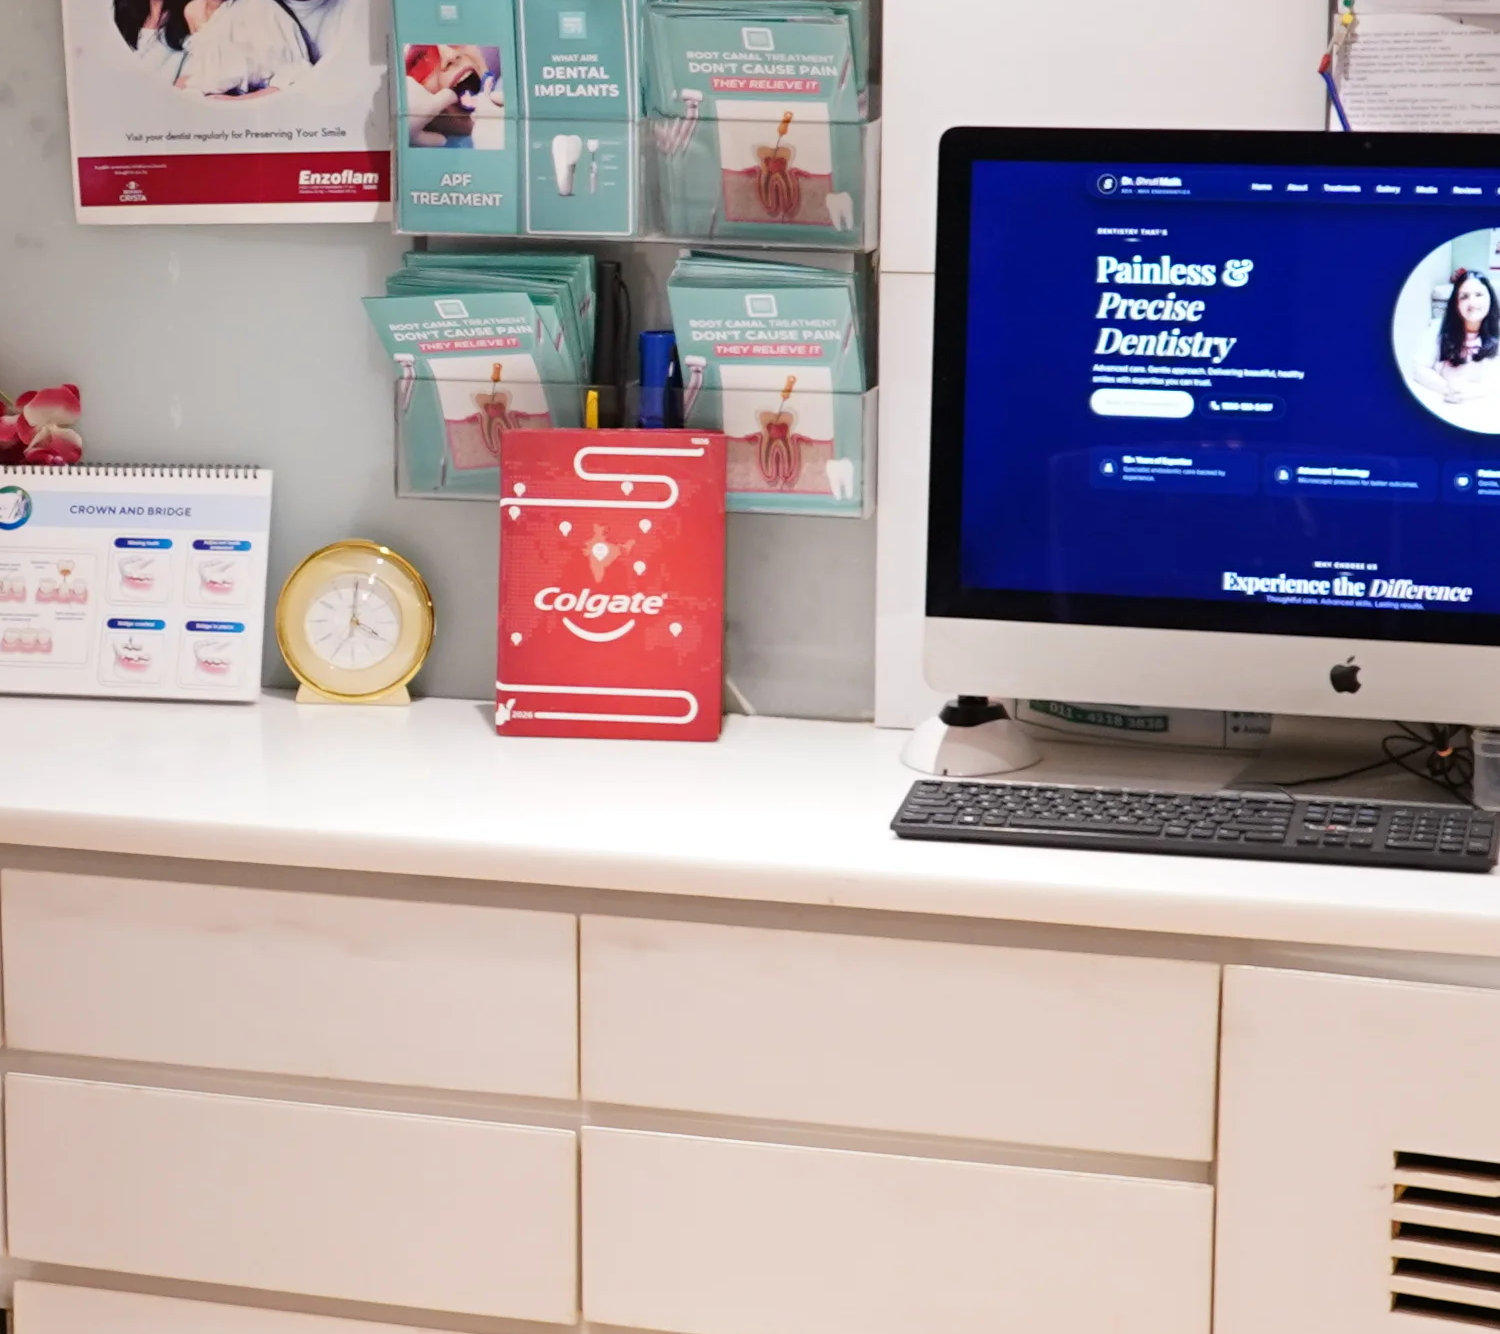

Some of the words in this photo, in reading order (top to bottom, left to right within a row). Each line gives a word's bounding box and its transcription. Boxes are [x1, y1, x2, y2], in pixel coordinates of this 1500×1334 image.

[552, 54, 577, 63] WHAT
[581, 54, 598, 63] ARE
[686, 51, 719, 59] ROOT
[723, 51, 762, 61] CANAL
[766, 53, 834, 63] TREATMENT
[543, 67, 609, 79] DENTAL
[688, 62, 738, 73] DON'T
[742, 64, 795, 75] CAUSE
[798, 65, 838, 76] PAIN
[535, 84, 619, 97] IMPLANTS
[712, 79, 746, 88] THEY
[749, 80, 802, 89] RELIEVE
[806, 81, 818, 89] IT
[126, 133, 143, 141] Visit
[146, 133, 163, 142] your
[166, 131, 191, 140] dentist
[193, 130, 229, 141] regularly
[231, 130, 242, 139] for
[245, 128, 292, 141] Preserving
[296, 128, 318, 137] Your
[321, 127, 346, 137] Smile
[299, 169, 379, 185] Enzoflam
[441, 174, 471, 186] APF
[1251, 183, 1272, 191] Home
[1287, 183, 1308, 191] About
[1324, 184, 1361, 193] Treatments
[1376, 185, 1400, 194] Gallery
[411, 191, 503, 206] TREATMENT
[1096, 255, 1216, 286] Painless
[1221, 259, 1253, 287] &
[1096, 291, 1204, 321] Precise
[422, 321, 460, 330] CANAL
[463, 317, 526, 325] TREATMENT
[689, 320, 723, 328] ROOT
[725, 320, 766, 328] CANAL
[394, 331, 439, 341] DON'T
[444, 327, 494, 338] CAUSE
[496, 325, 533, 335] PAIN
[692, 331, 740, 341] DON'T
[745, 330, 796, 341] CAUSE
[802, 330, 841, 340] PAIN
[420, 342, 451, 350] THEY
[454, 339, 504, 349] RELIEVE
[716, 345, 750, 354] THEY
[752, 345, 806, 355] RELIEVE
[809, 345, 821, 354] IT
[1094, 328, 1236, 363] Dentistry
[70, 504, 116, 516] CROWN
[119, 506, 145, 516] AND
[147, 506, 192, 517] BRIDGE
[1313, 561, 1332, 569] WHY
[1334, 562, 1365, 570] CHOOSE
[1223, 572, 1330, 596] Experience
[1333, 575, 1365, 597] the
[1369, 579, 1473, 602] Difference
[534, 587, 664, 618] Colgate
[1266, 595, 1301, 605] Thoughtful
[1320, 598, 1354, 607] Advanced
[1355, 600, 1374, 608] skills.
[1375, 601, 1399, 610] Lasting
